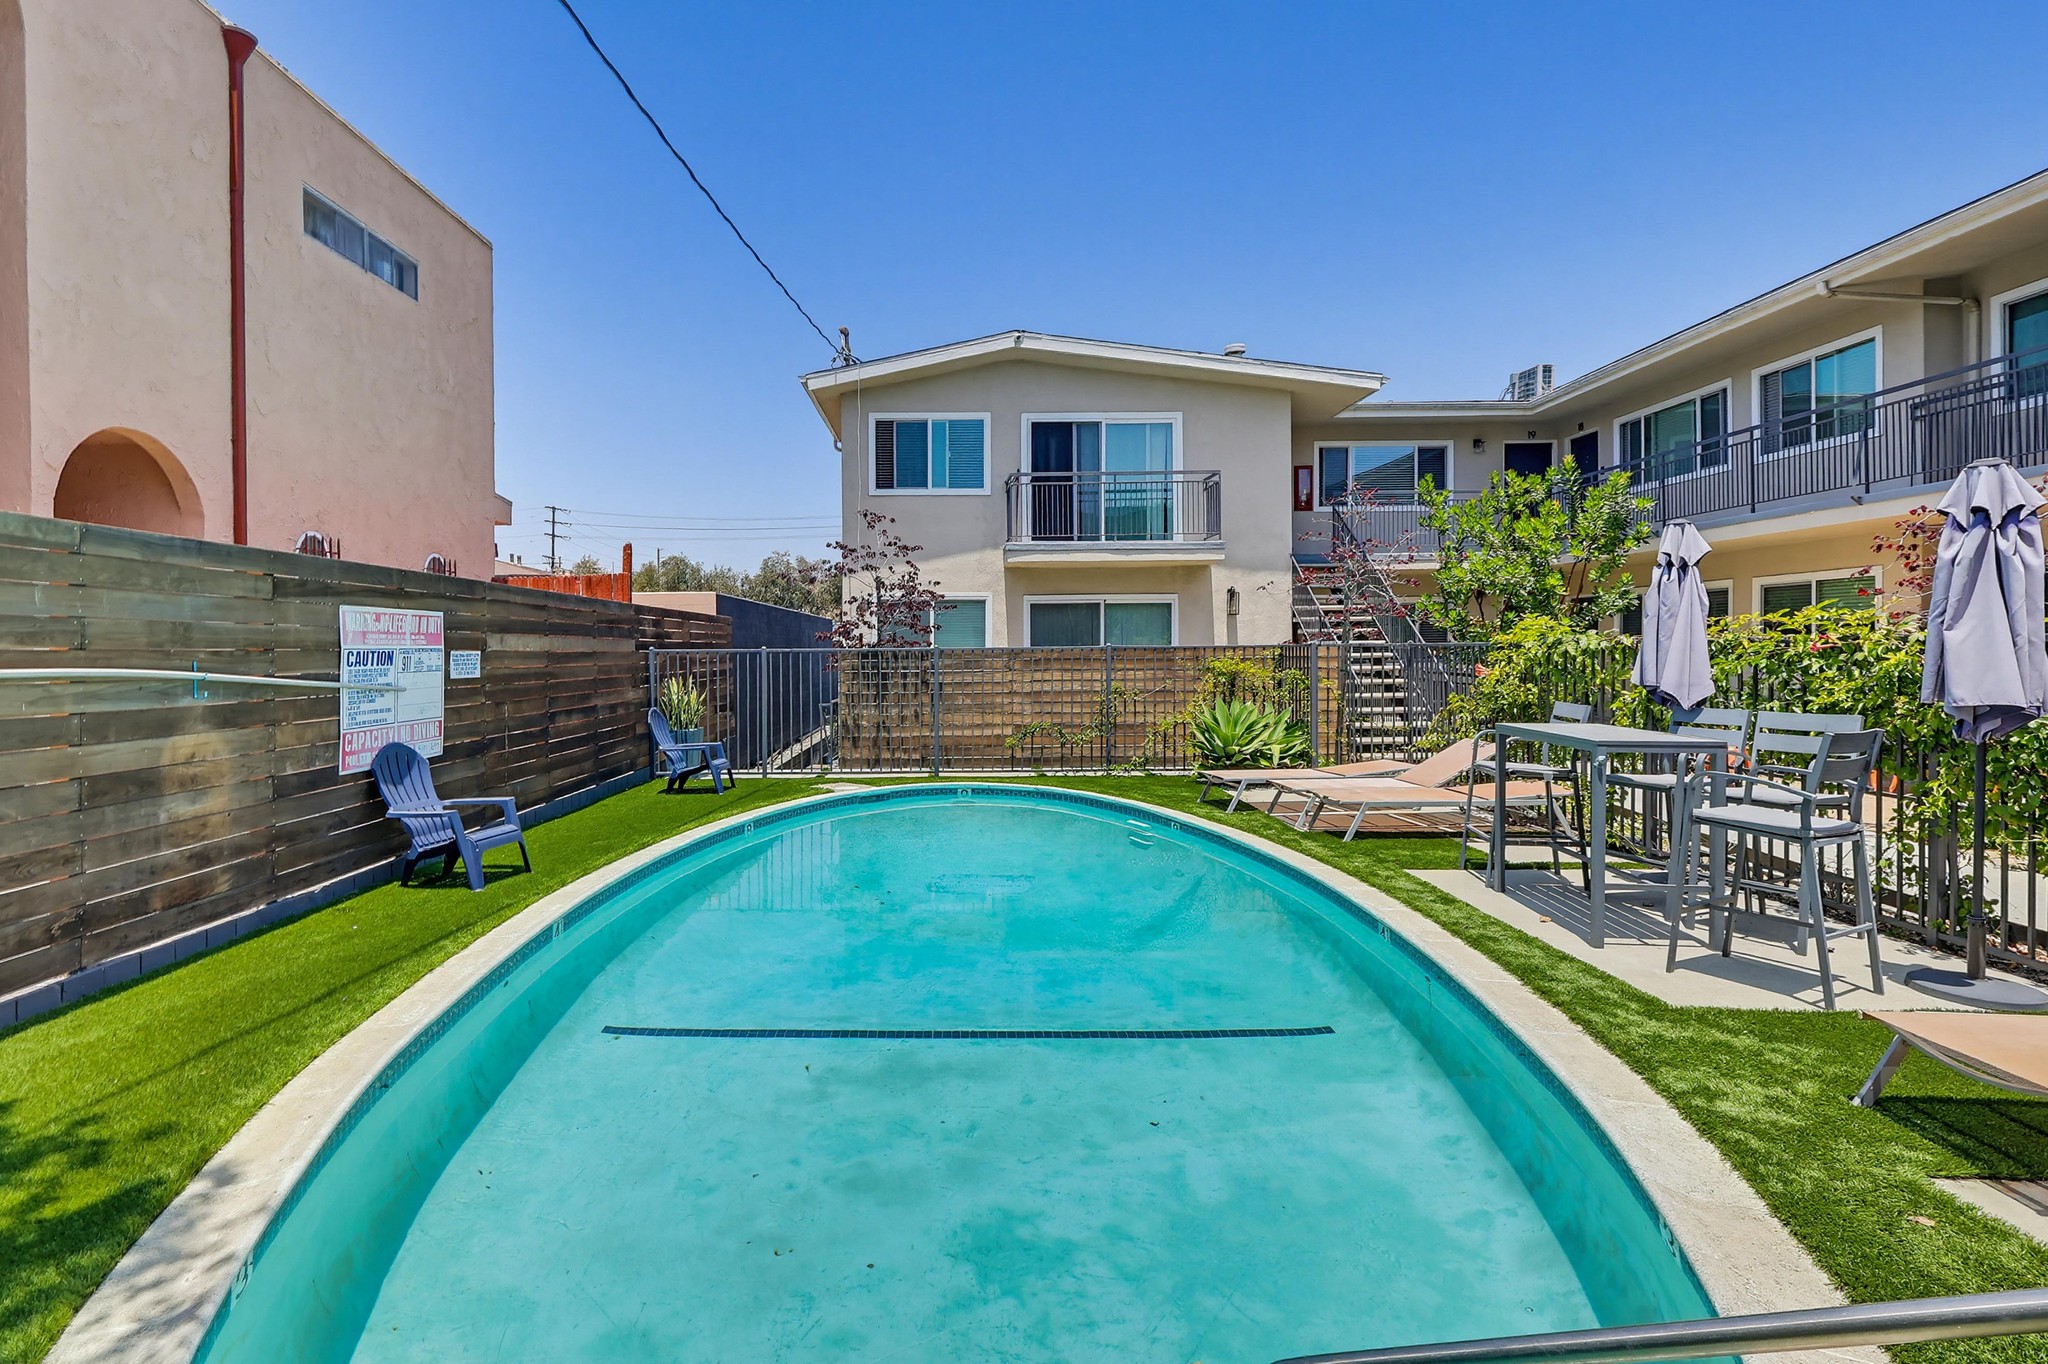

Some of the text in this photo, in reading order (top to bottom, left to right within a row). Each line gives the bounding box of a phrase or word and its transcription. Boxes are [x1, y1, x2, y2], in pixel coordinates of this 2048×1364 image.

[1527, 430, 1537, 439] 19
[346, 650, 394, 668] CAUTION
[401, 656, 412, 672] 911
[345, 727, 394, 752] CAPACITY
[401, 721, 440, 743] NO DIVING
